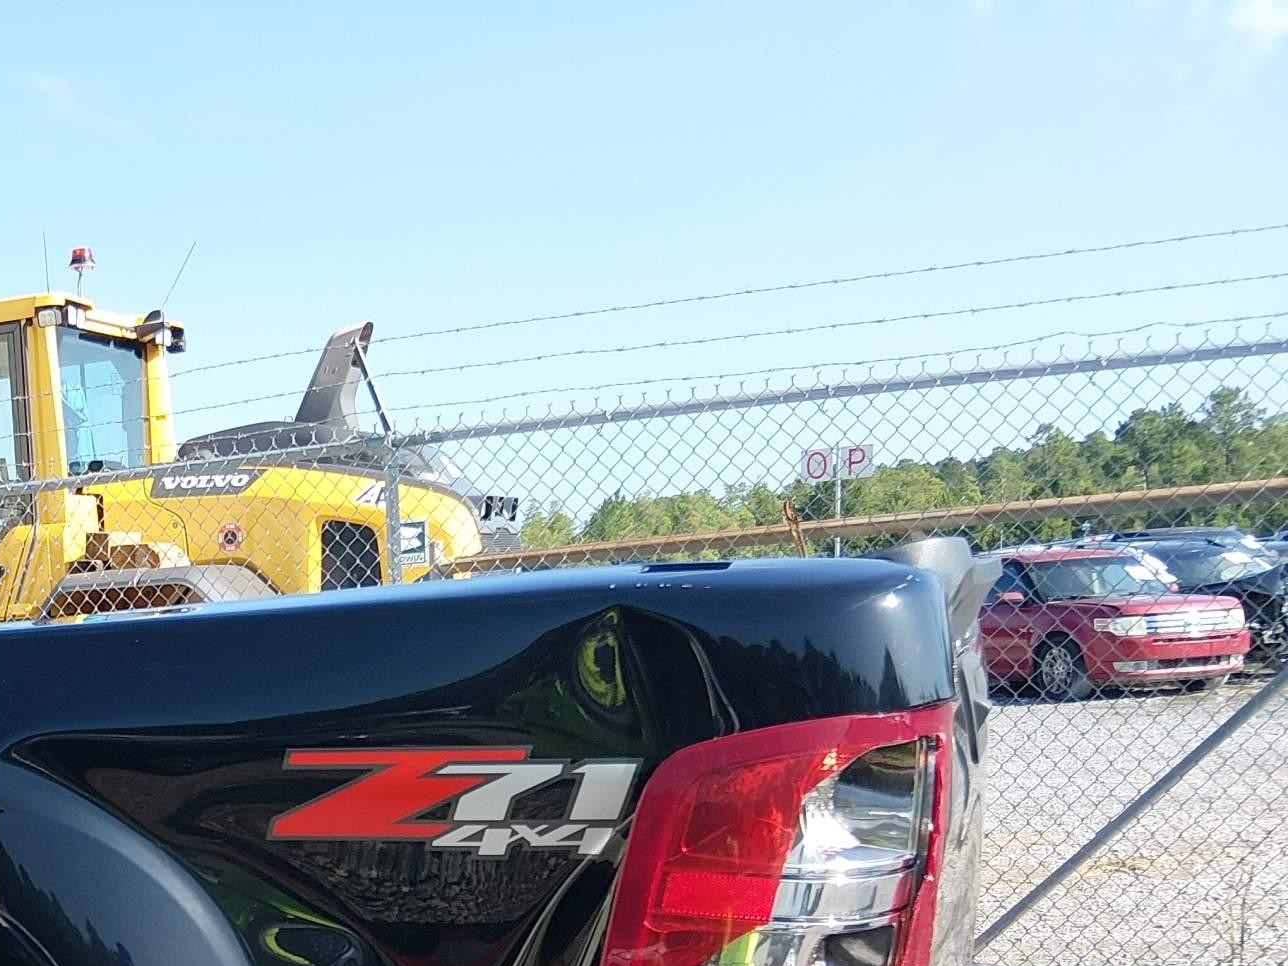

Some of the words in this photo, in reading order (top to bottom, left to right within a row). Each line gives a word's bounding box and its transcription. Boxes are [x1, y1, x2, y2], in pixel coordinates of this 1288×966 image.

[848, 447, 866, 476] P
[161, 474, 250, 490] VOLVO
[267, 746, 642, 840] Z71
